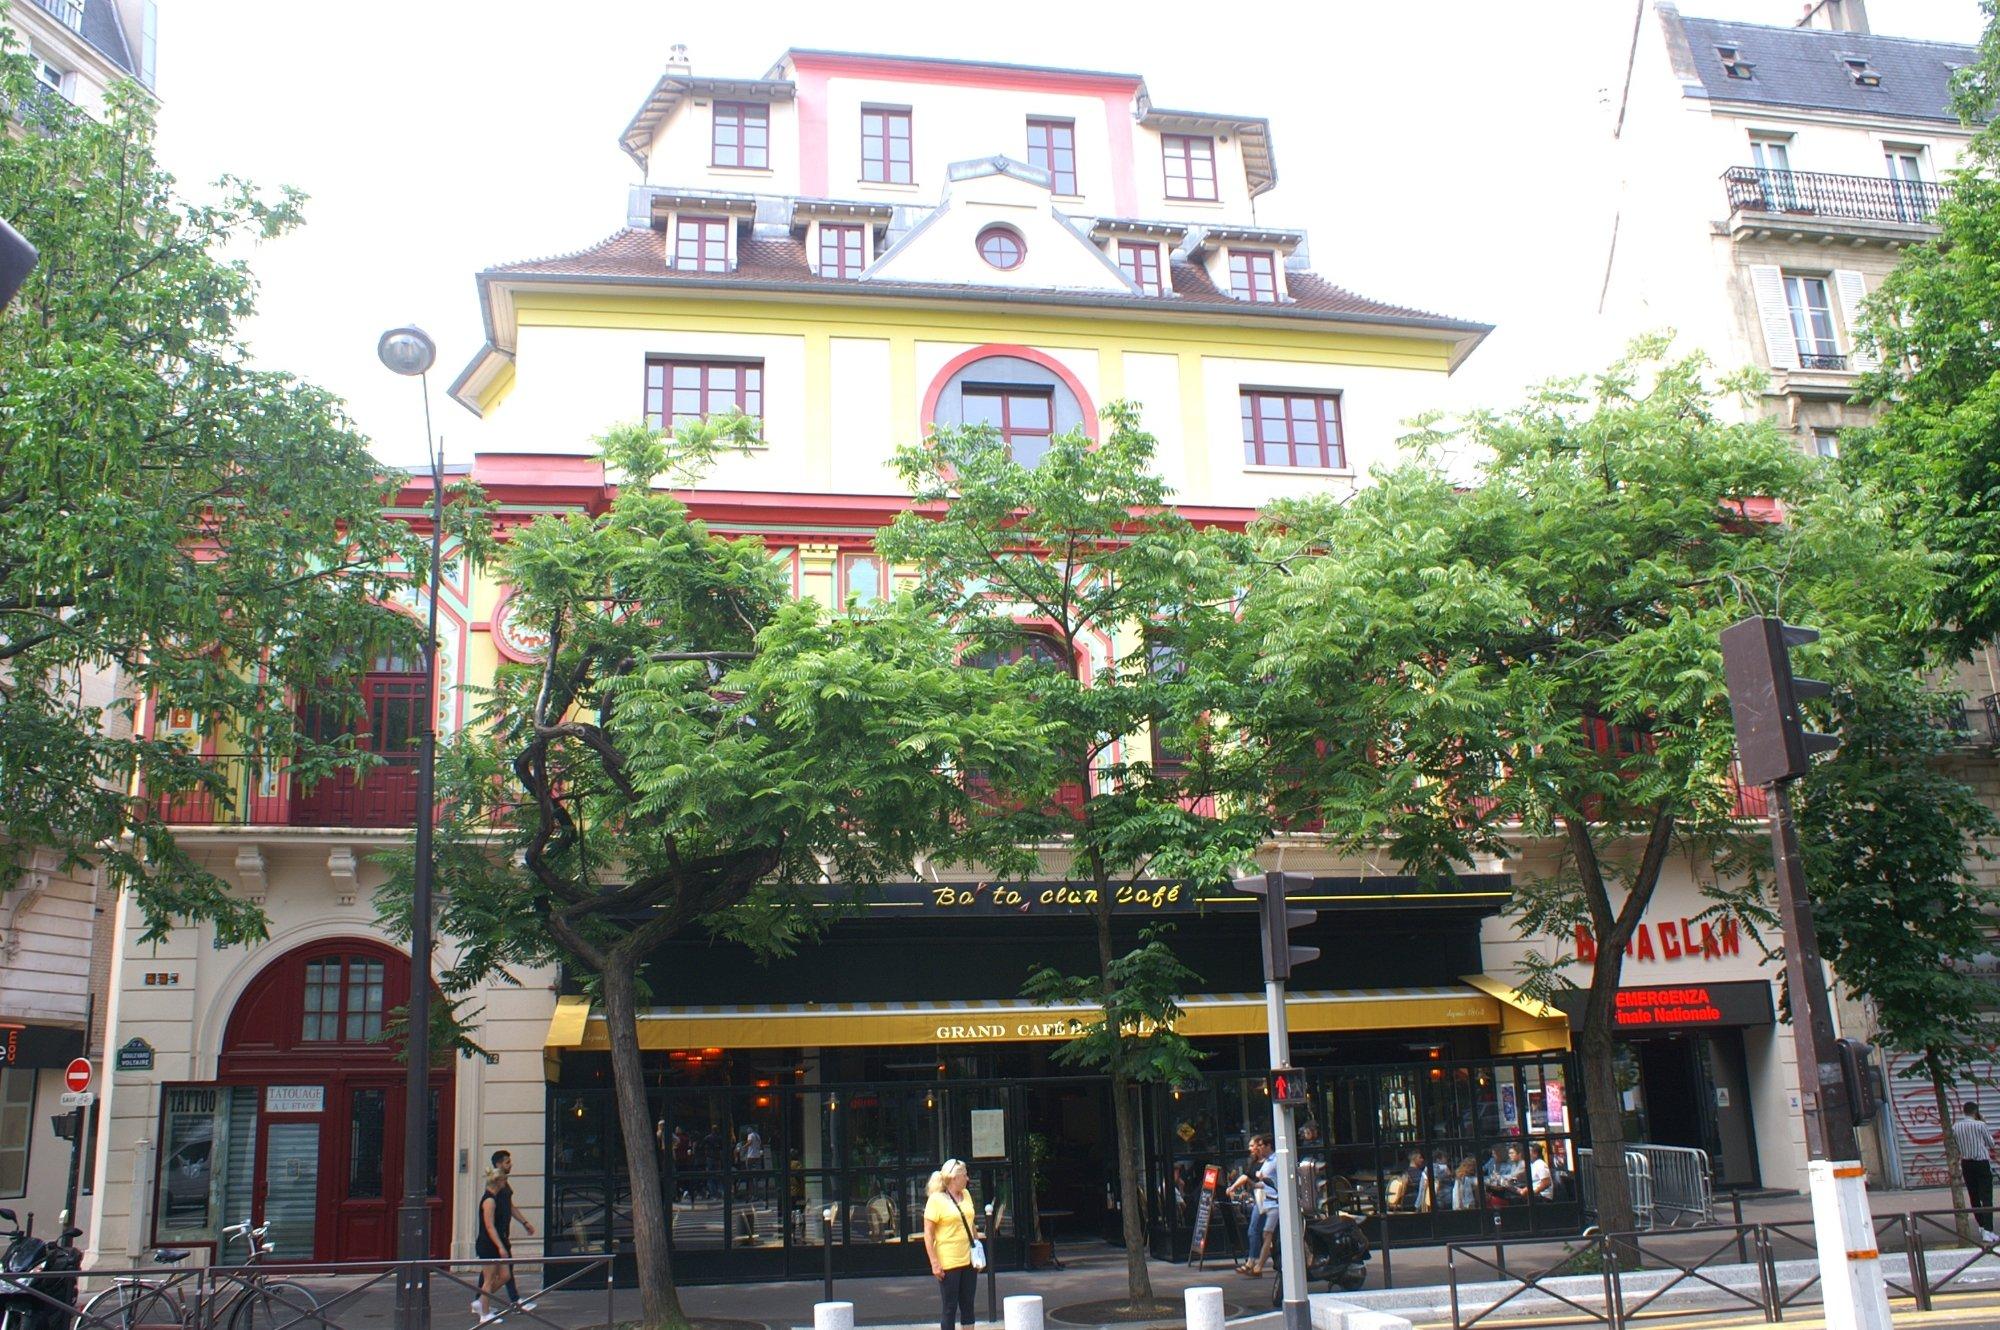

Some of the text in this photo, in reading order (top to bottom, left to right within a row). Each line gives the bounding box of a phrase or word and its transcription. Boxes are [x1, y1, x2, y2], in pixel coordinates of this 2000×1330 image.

[1616, 989, 1709, 1007] EMERGENZA
[1615, 1008, 1721, 1025] inale Nationale
[936, 1024, 1006, 1039] GRAND
[1017, 1020, 1066, 1037] CAFÉ
[170, 1090, 216, 1112] TATTOO
[268, 1087, 321, 1099] TATOUAGE
